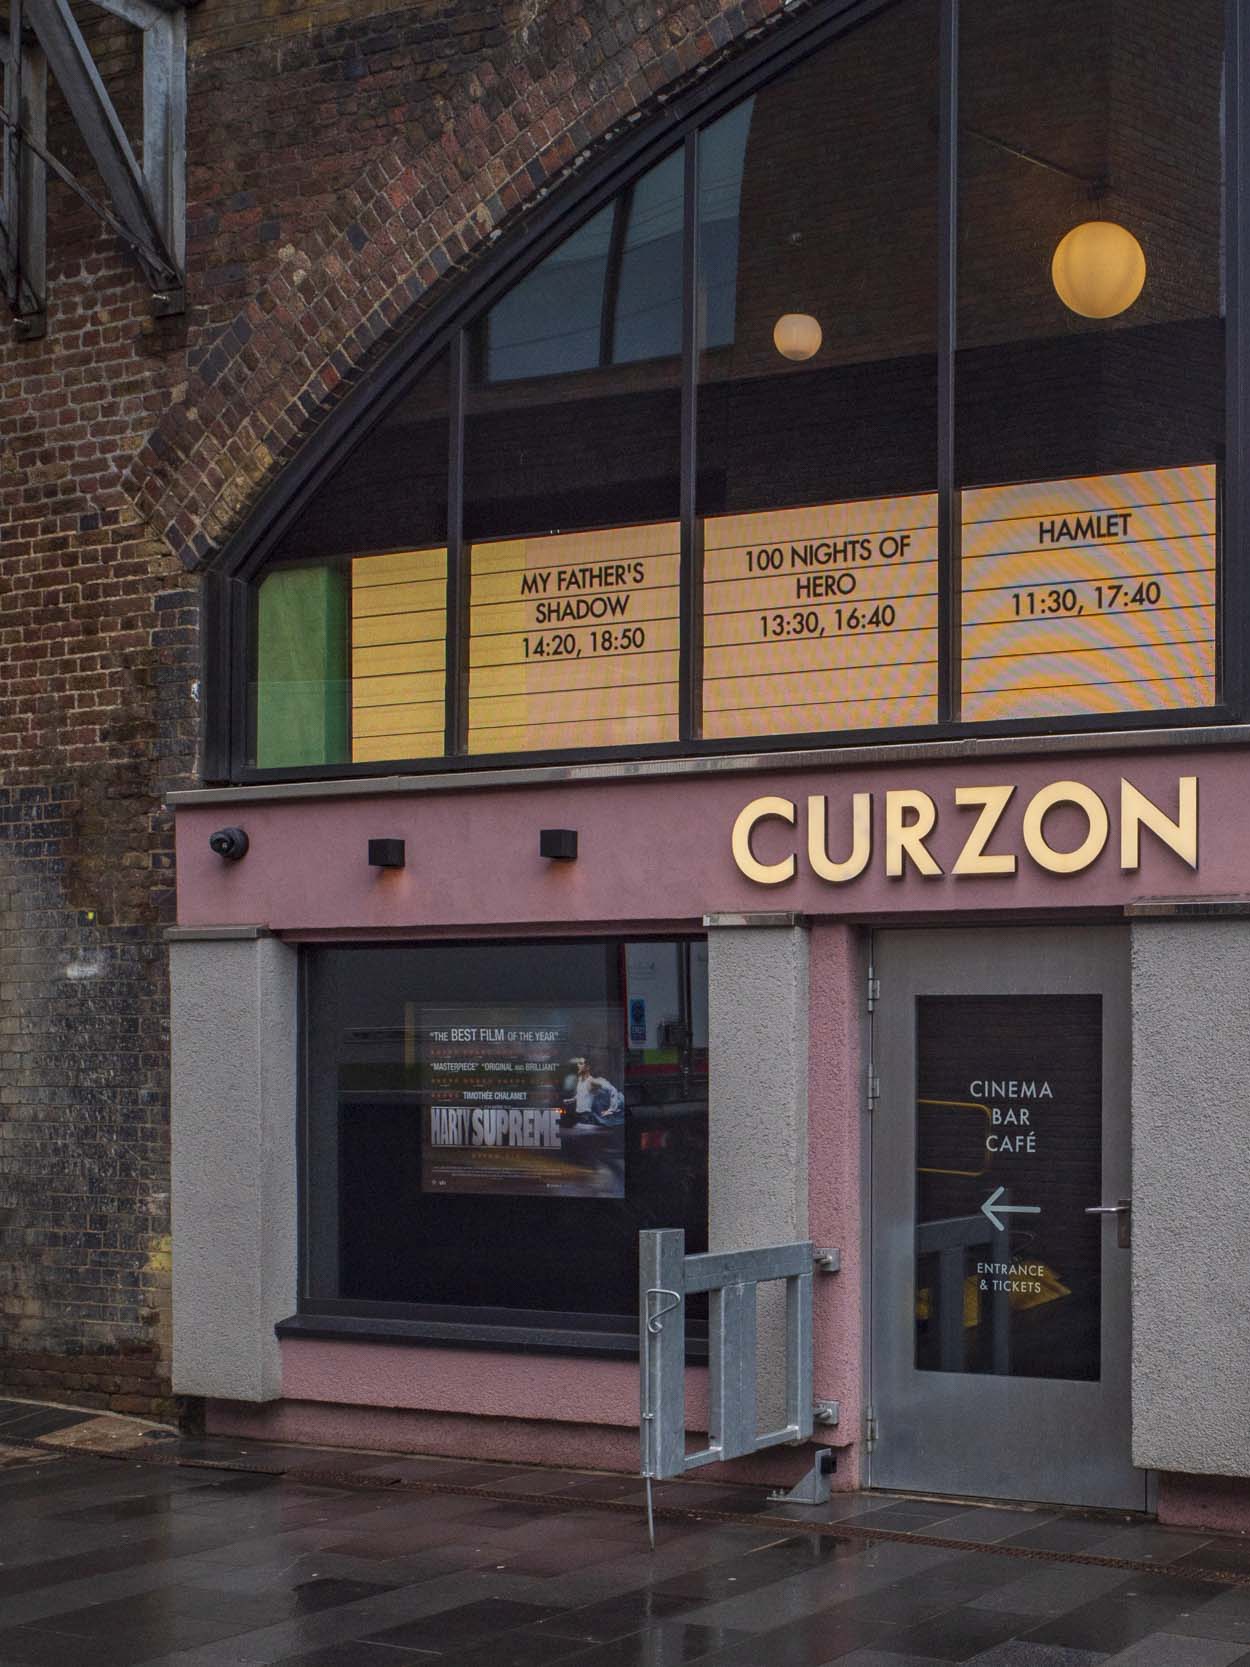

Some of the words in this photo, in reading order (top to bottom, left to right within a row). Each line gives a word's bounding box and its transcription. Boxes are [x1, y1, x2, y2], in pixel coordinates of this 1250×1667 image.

[1039, 513, 1132, 544] HAMLET
[745, 547, 783, 573] 100
[791, 538, 872, 568] NIGHTS
[880, 535, 911, 559] OF
[521, 571, 551, 596] MY
[556, 562, 645, 592] FATHER'S
[796, 573, 857, 599] HERO
[536, 595, 630, 624] SHADOW
[1012, 587, 1085, 616] 11:30,
[1094, 580, 1161, 610] 17:40
[760, 610, 826, 638] 13:30,
[834, 604, 896, 631] 16:40
[522, 633, 582, 658] 14:20,
[590, 626, 645, 653] 18:50
[731, 776, 1200, 885] CURZON
[451, 1028, 477, 1042] BEST
[480, 1028, 504, 1042] FILM
[507, 1031, 518, 1041] OF
[519, 1031, 534, 1041] THE
[970, 1080, 1053, 1099] CINEMA
[431, 1108, 471, 1146] MARTY
[471, 1108, 561, 1146] SUPREME
[992, 1108, 1030, 1126] BAR
[985, 1132, 1037, 1153] CAFÉ
[977, 1262, 1045, 1277] ENTRANCE
[979, 1279, 989, 1291] &
[992, 1279, 1041, 1293] TICKETS
